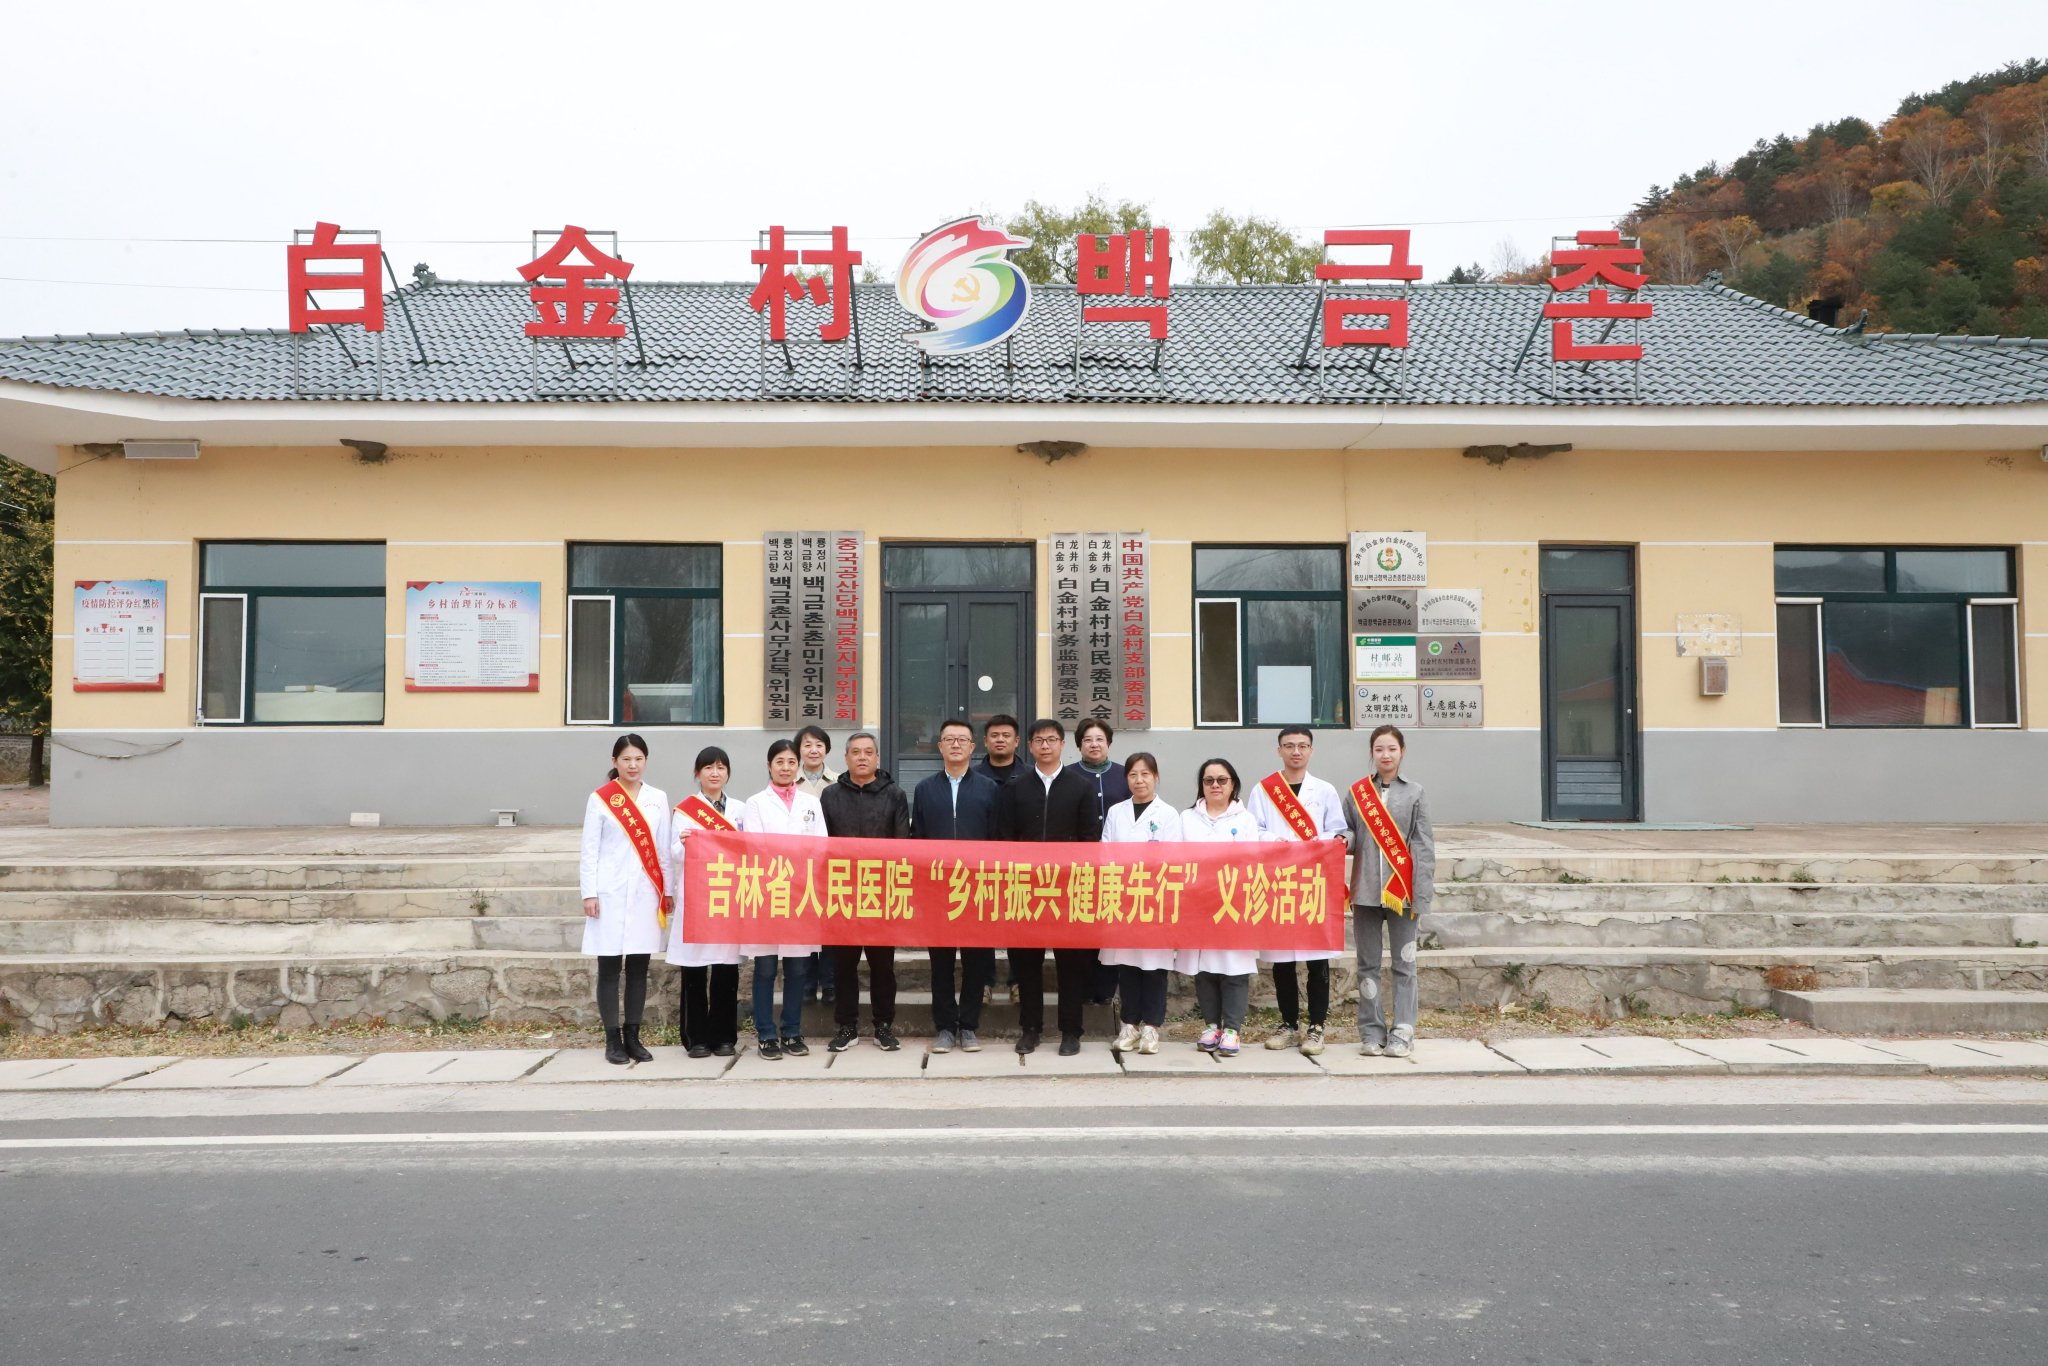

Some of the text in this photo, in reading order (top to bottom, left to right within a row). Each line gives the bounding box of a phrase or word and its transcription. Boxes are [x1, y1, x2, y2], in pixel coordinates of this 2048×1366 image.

[287, 221, 862, 341] 白金村
[1077, 228, 1652, 361] 백금촌
[802, 538, 812, 572] 백금향
[1055, 540, 1065, 573] 白金乡
[1069, 540, 1079, 573] 龙井市
[1088, 540, 1098, 573] 白金乡
[1101, 540, 1112, 573] 龙井市
[82, 598, 159, 609] 疫情防控评分红黑榜
[428, 599, 518, 609] 乡村治理评分标准
[1122, 540, 1146, 721] 中国共产党白金村支部委员会
[768, 576, 793, 721] 백금촌사무감독위원회
[802, 576, 826, 719] 백금촌촌민위원회
[1057, 577, 1079, 719] 白金村村务监督委员会
[1089, 577, 1112, 719] 白金村村民委员会
[1365, 704, 1408, 713] 文明实践站
[1371, 693, 1403, 703] 新时代
[1427, 700, 1477, 710] 志愿服务站
